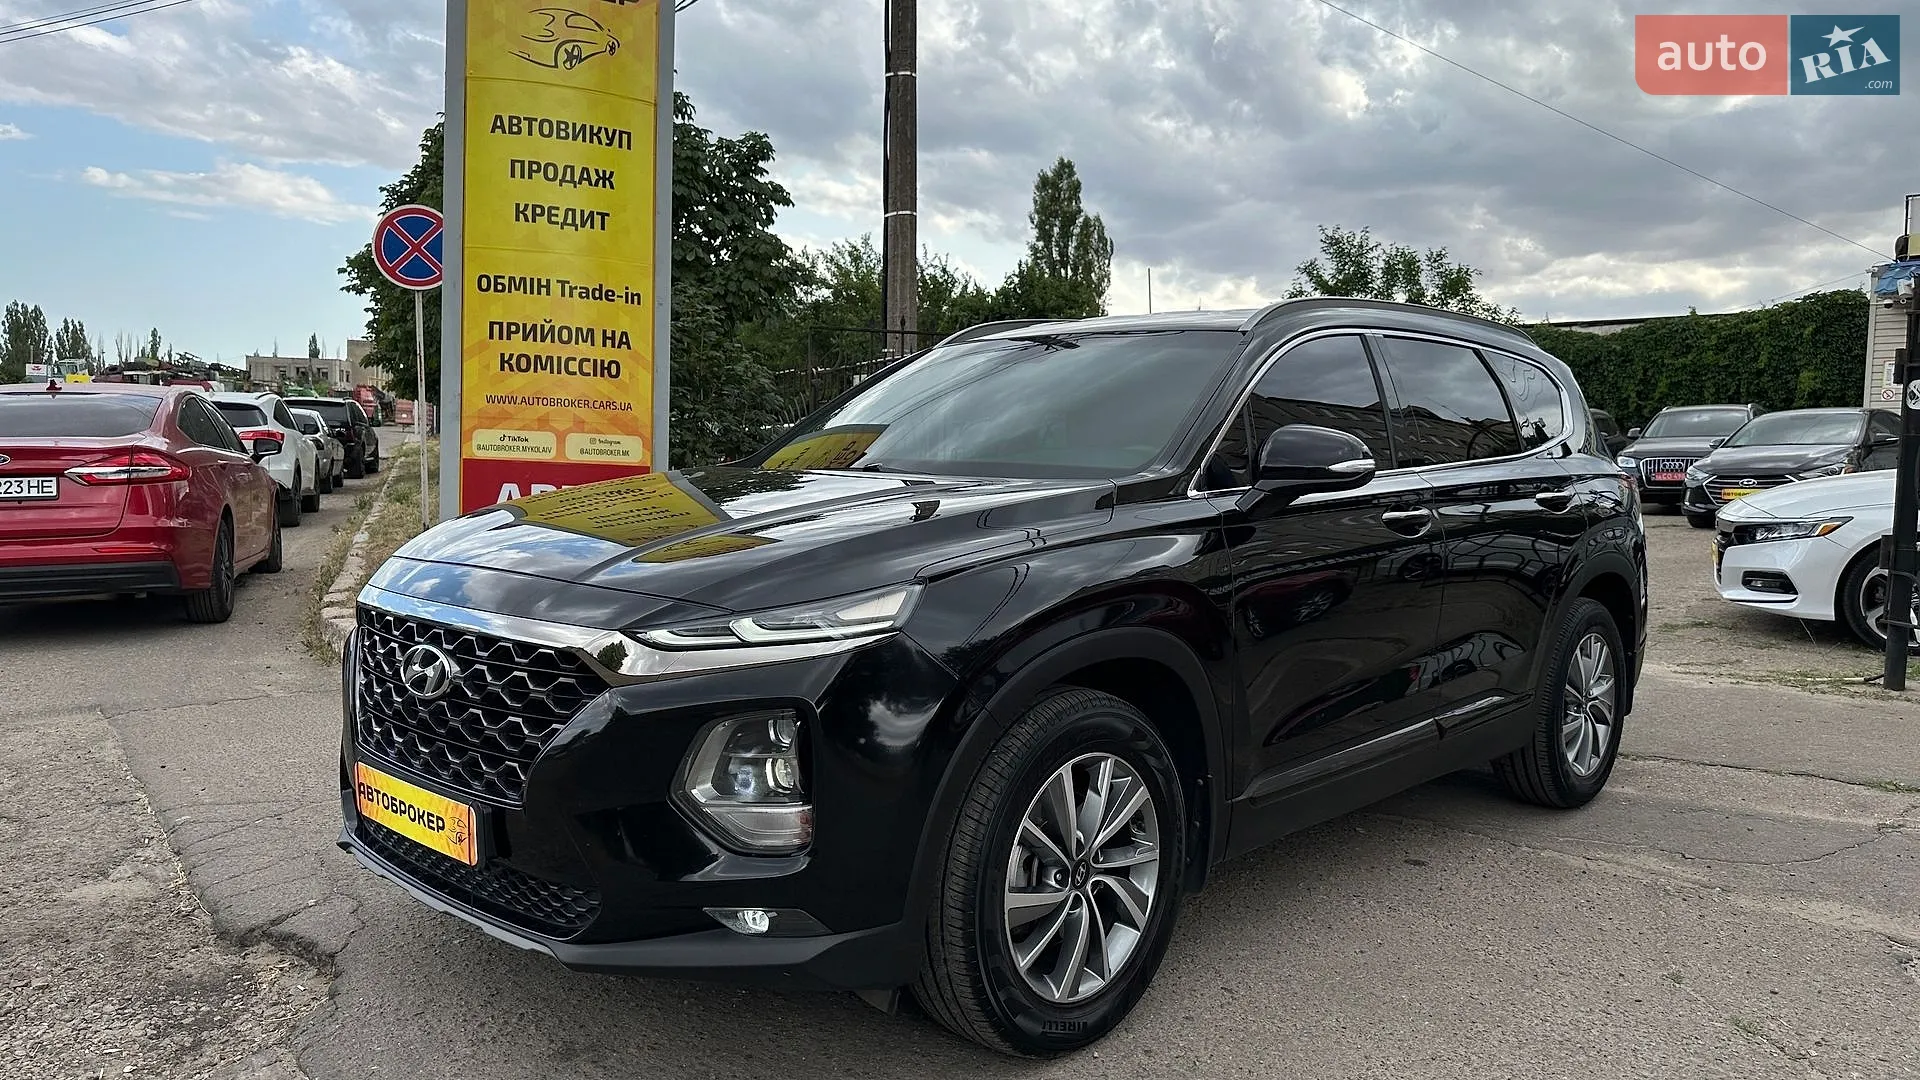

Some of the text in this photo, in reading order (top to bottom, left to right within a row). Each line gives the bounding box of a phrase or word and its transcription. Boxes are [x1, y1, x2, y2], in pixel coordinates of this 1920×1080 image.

[490, 114, 632, 151] АВТОВИКУП
[509, 159, 615, 190] ПРОДАЖ
[514, 202, 610, 232] КРЕДИТ
[476, 273, 642, 306] ОБМІН Trade-in
[488, 319, 632, 350] ПРИЙОМ НА
[499, 352, 621, 379] КОМІССІЮ
[485, 394, 633, 412] WWW.AUTOBROKER.CARS.UA
[507, 435, 529, 443] TikTok
[0, 479, 54, 495] 23 HE
[359, 781, 446, 833] АВТОБРОКЕР
